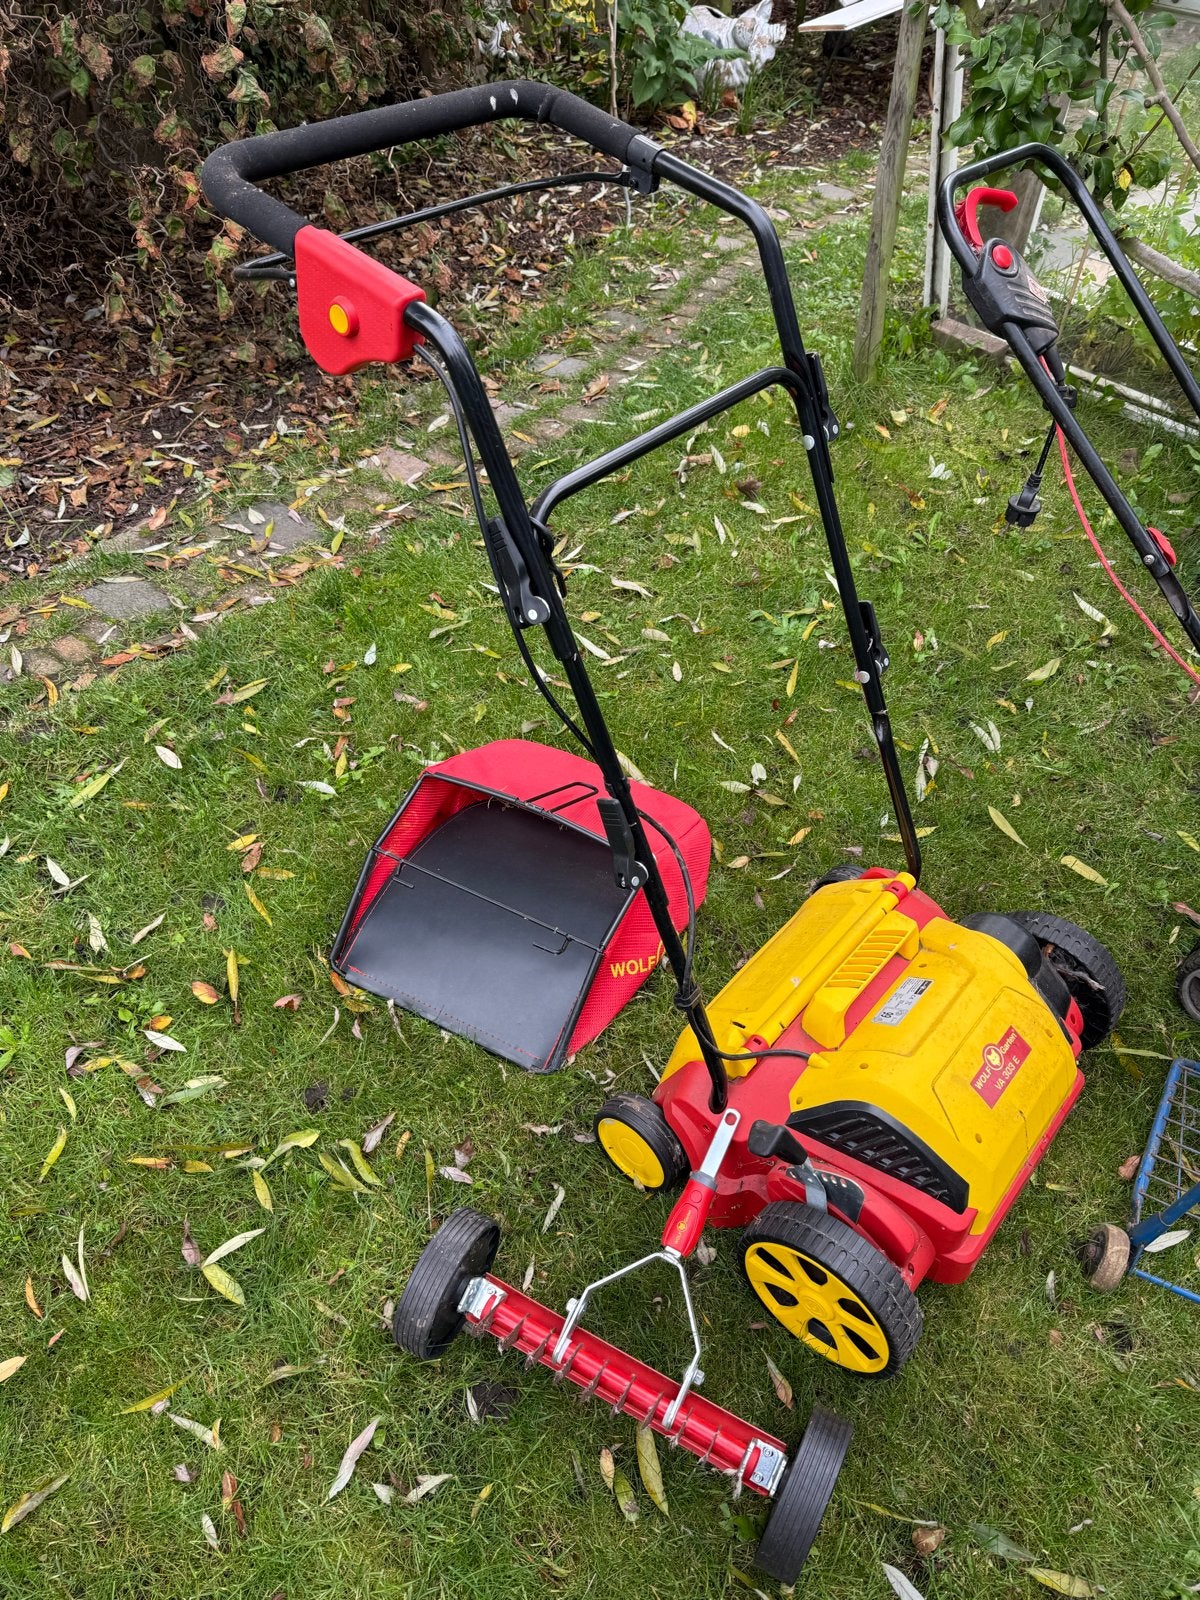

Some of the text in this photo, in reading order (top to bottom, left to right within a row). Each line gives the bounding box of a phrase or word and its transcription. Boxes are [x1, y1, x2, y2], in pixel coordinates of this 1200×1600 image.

[610, 956, 656, 978] WOLF
[975, 1032, 1017, 1090] WOLF Garten
[994, 1055, 1020, 1090] VA 303 E
